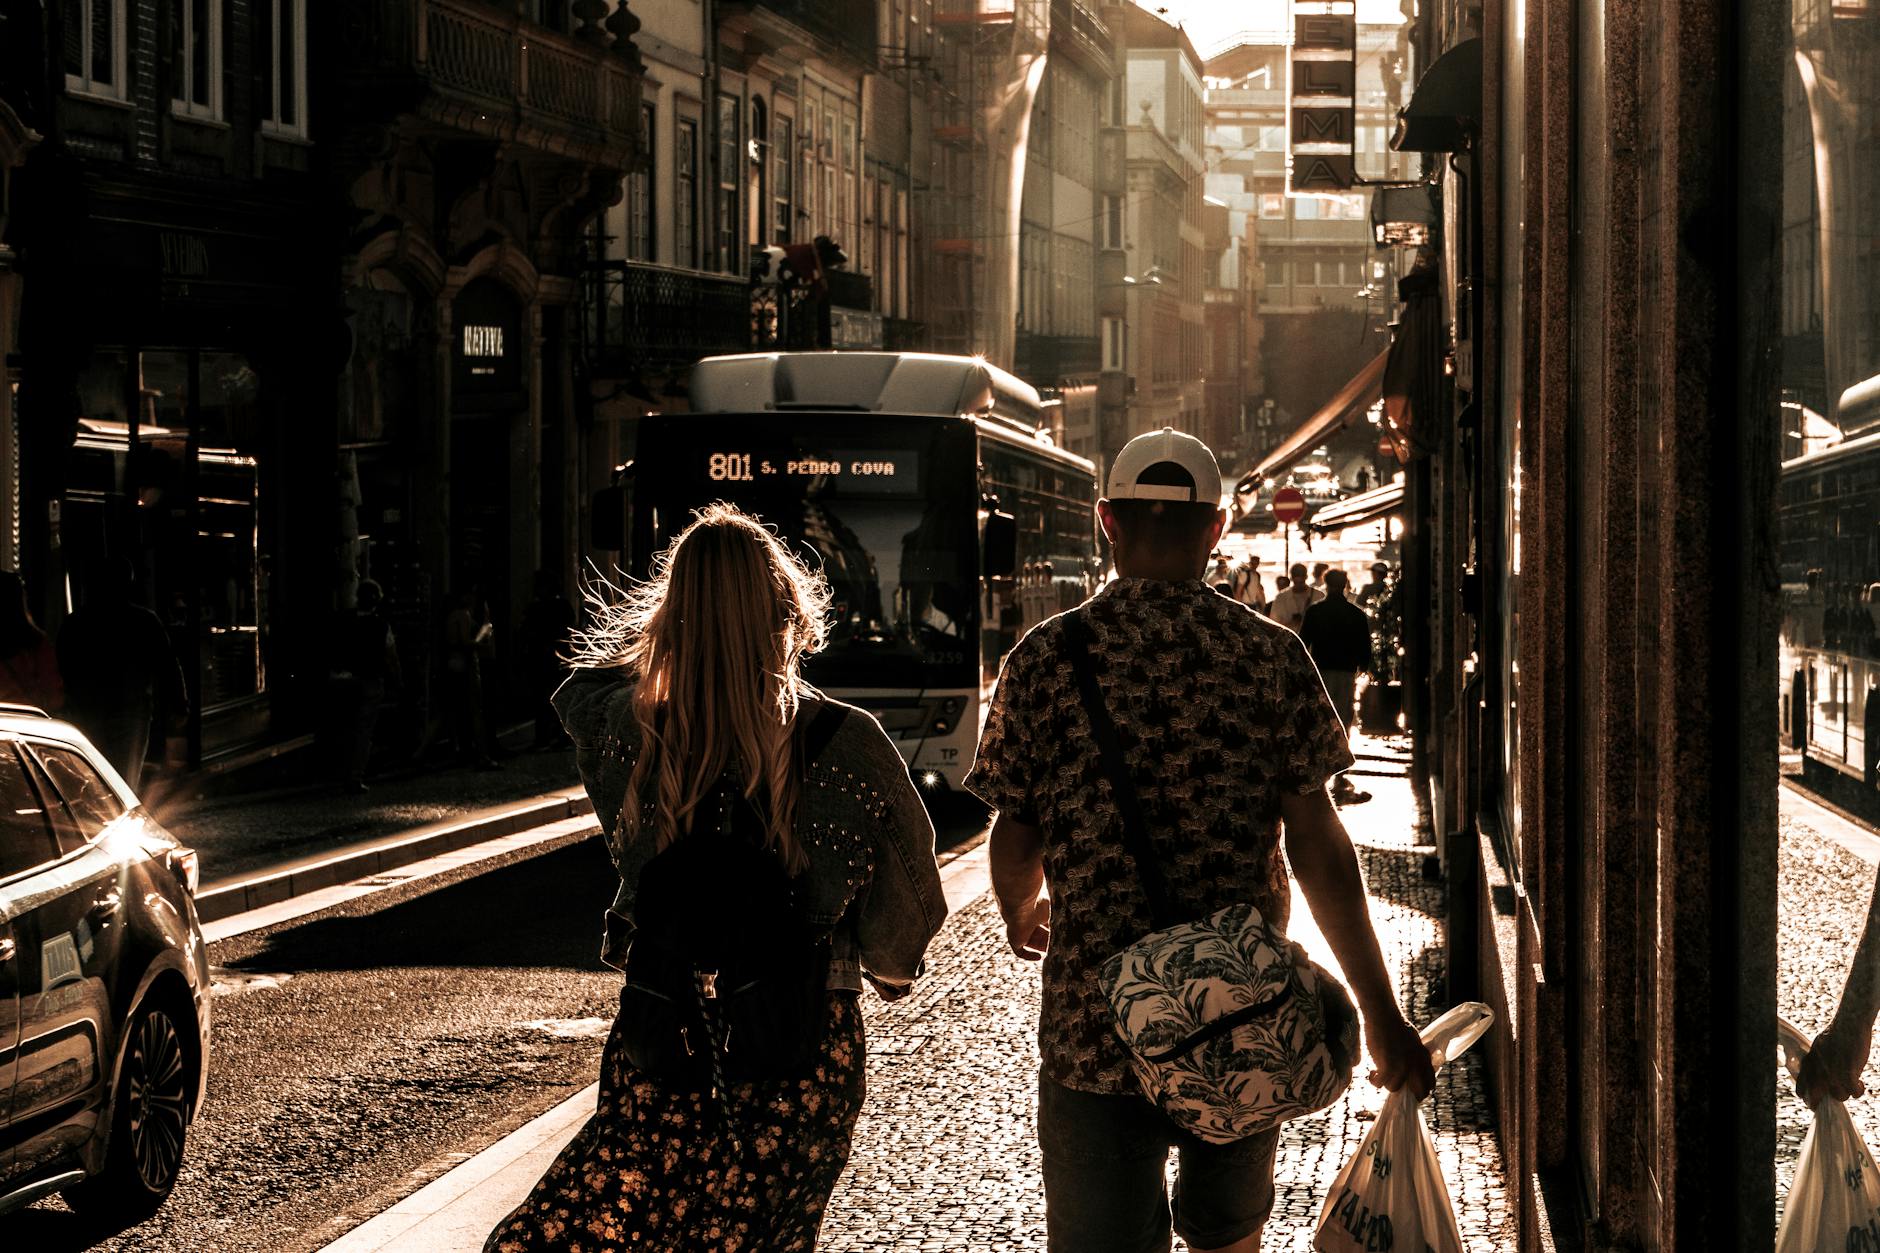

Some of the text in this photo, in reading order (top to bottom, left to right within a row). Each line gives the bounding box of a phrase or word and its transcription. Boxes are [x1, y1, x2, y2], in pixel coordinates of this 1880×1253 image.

[708, 453, 754, 481] 801
[786, 461, 841, 476] PEDRO
[850, 462, 896, 476] COVA
